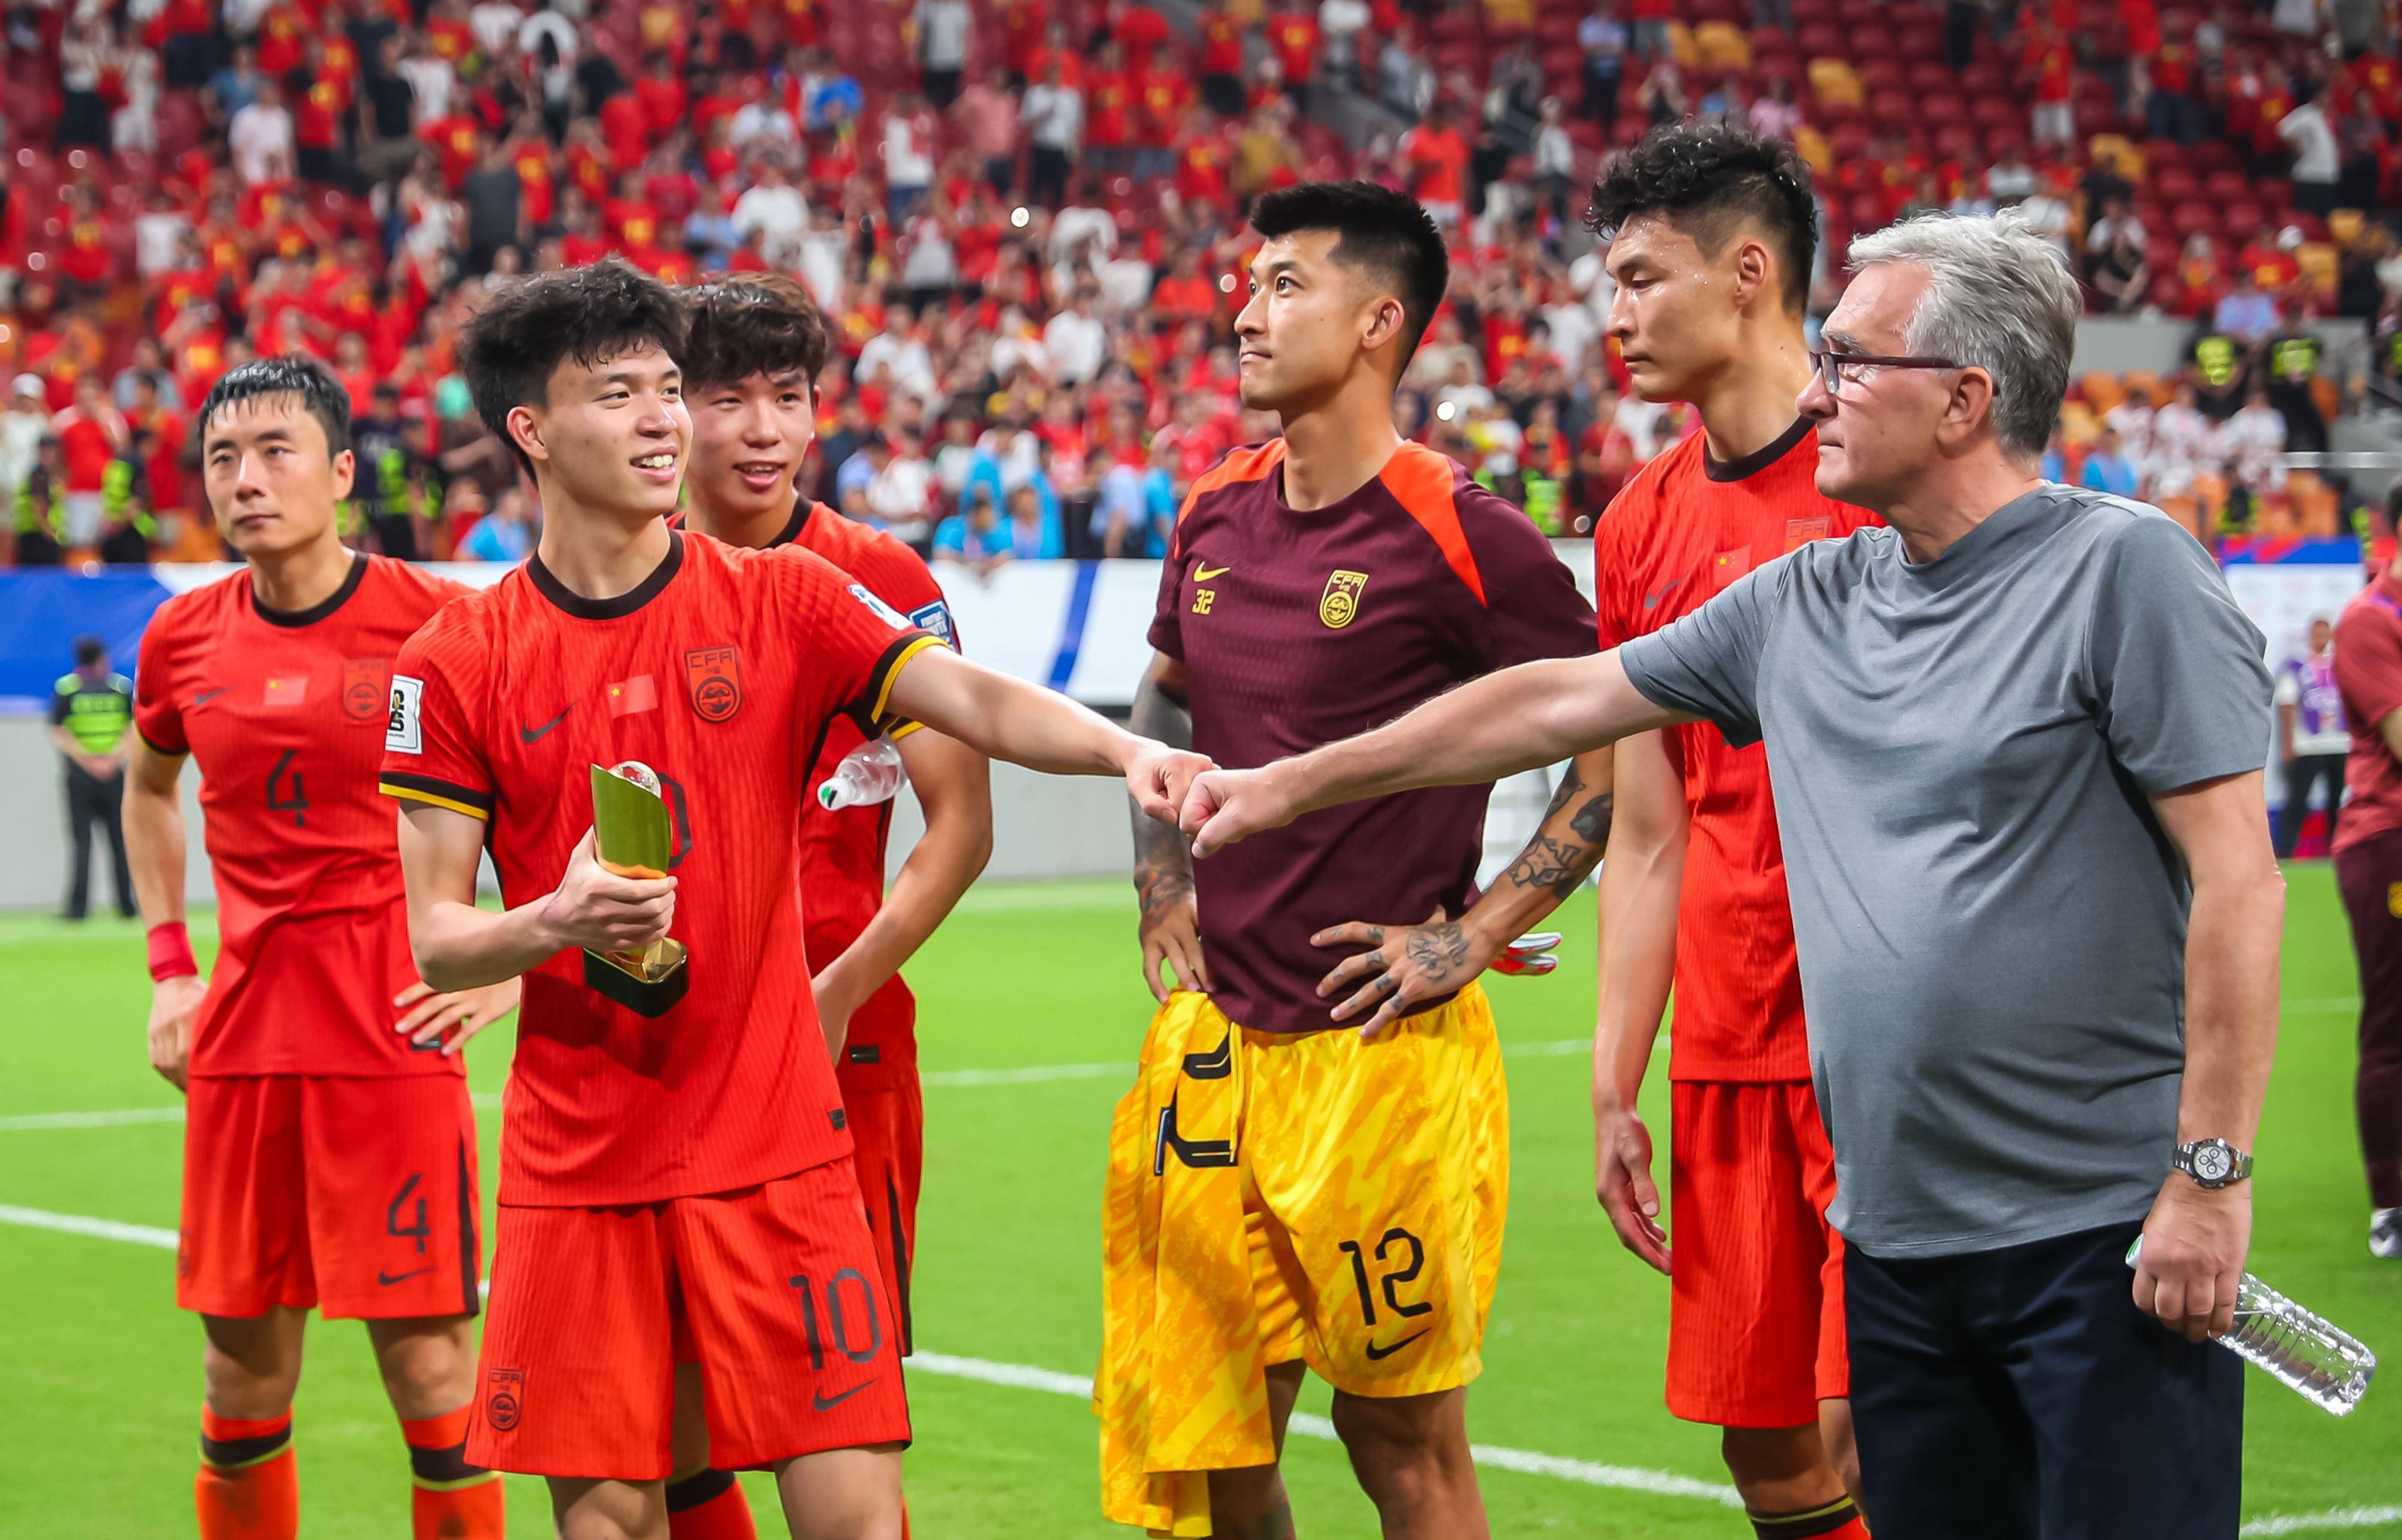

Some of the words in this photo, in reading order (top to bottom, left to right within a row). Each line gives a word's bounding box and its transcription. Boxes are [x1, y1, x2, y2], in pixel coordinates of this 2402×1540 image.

[1191, 588, 1215, 615] 32
[1332, 574, 1363, 587] CFA
[691, 650, 732, 668] CFA
[266, 749, 309, 827] 4
[387, 1173, 431, 1254] 4
[1339, 1227, 1433, 1326] 12
[788, 1267, 882, 1370] 10
[491, 1372, 520, 1383] CFA
